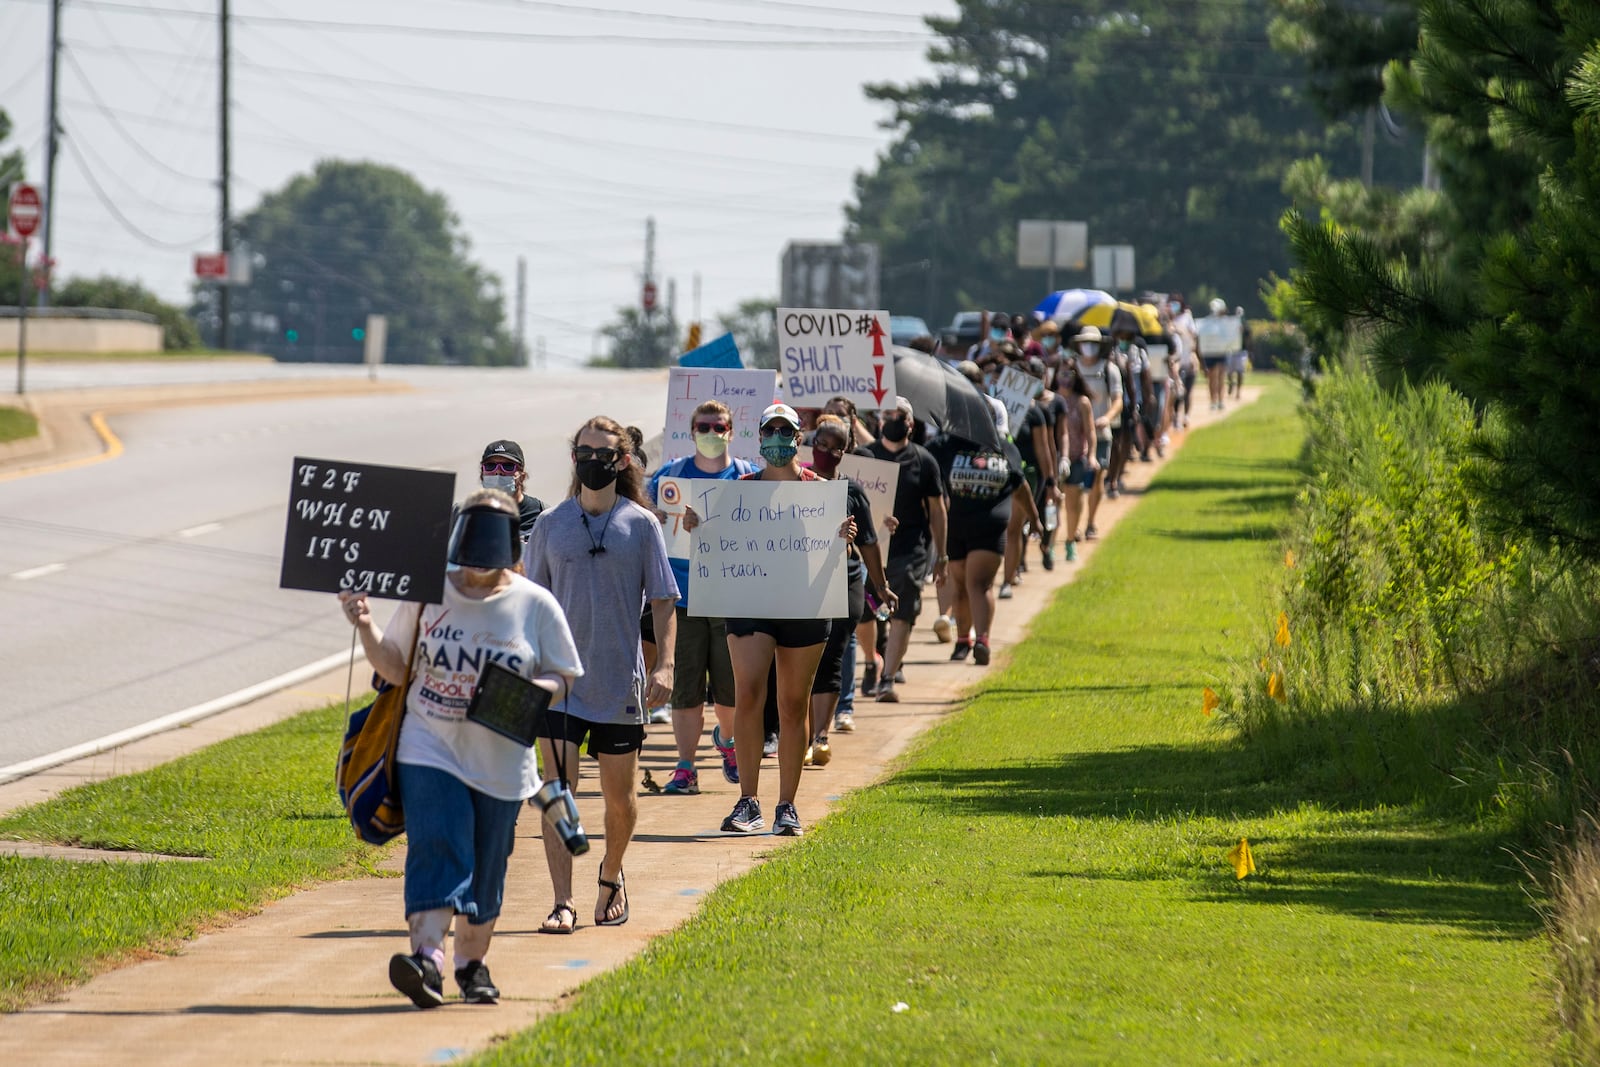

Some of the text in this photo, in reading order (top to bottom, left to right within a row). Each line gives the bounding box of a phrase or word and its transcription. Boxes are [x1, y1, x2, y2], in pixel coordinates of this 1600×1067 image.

[785, 313, 852, 337] COVID
[785, 345, 844, 373] SHUT
[676, 374, 757, 400] I Deserve
[789, 375, 875, 397] BUILDINGS
[1003, 371, 1037, 396] NOT
[953, 454, 1008, 472] BLCK
[295, 499, 391, 531] WHEN
[698, 486, 721, 524] I
[731, 494, 751, 522] do
[759, 503, 785, 521] not
[791, 501, 826, 519] need
[306, 536, 360, 563] IT'S
[697, 535, 832, 554] to be in a classroom
[339, 568, 411, 595] SAFE
[697, 560, 768, 578] to teach.
[424, 609, 464, 641] Vote
[424, 673, 466, 698] SCHOOL
[452, 672, 476, 684] FOR
